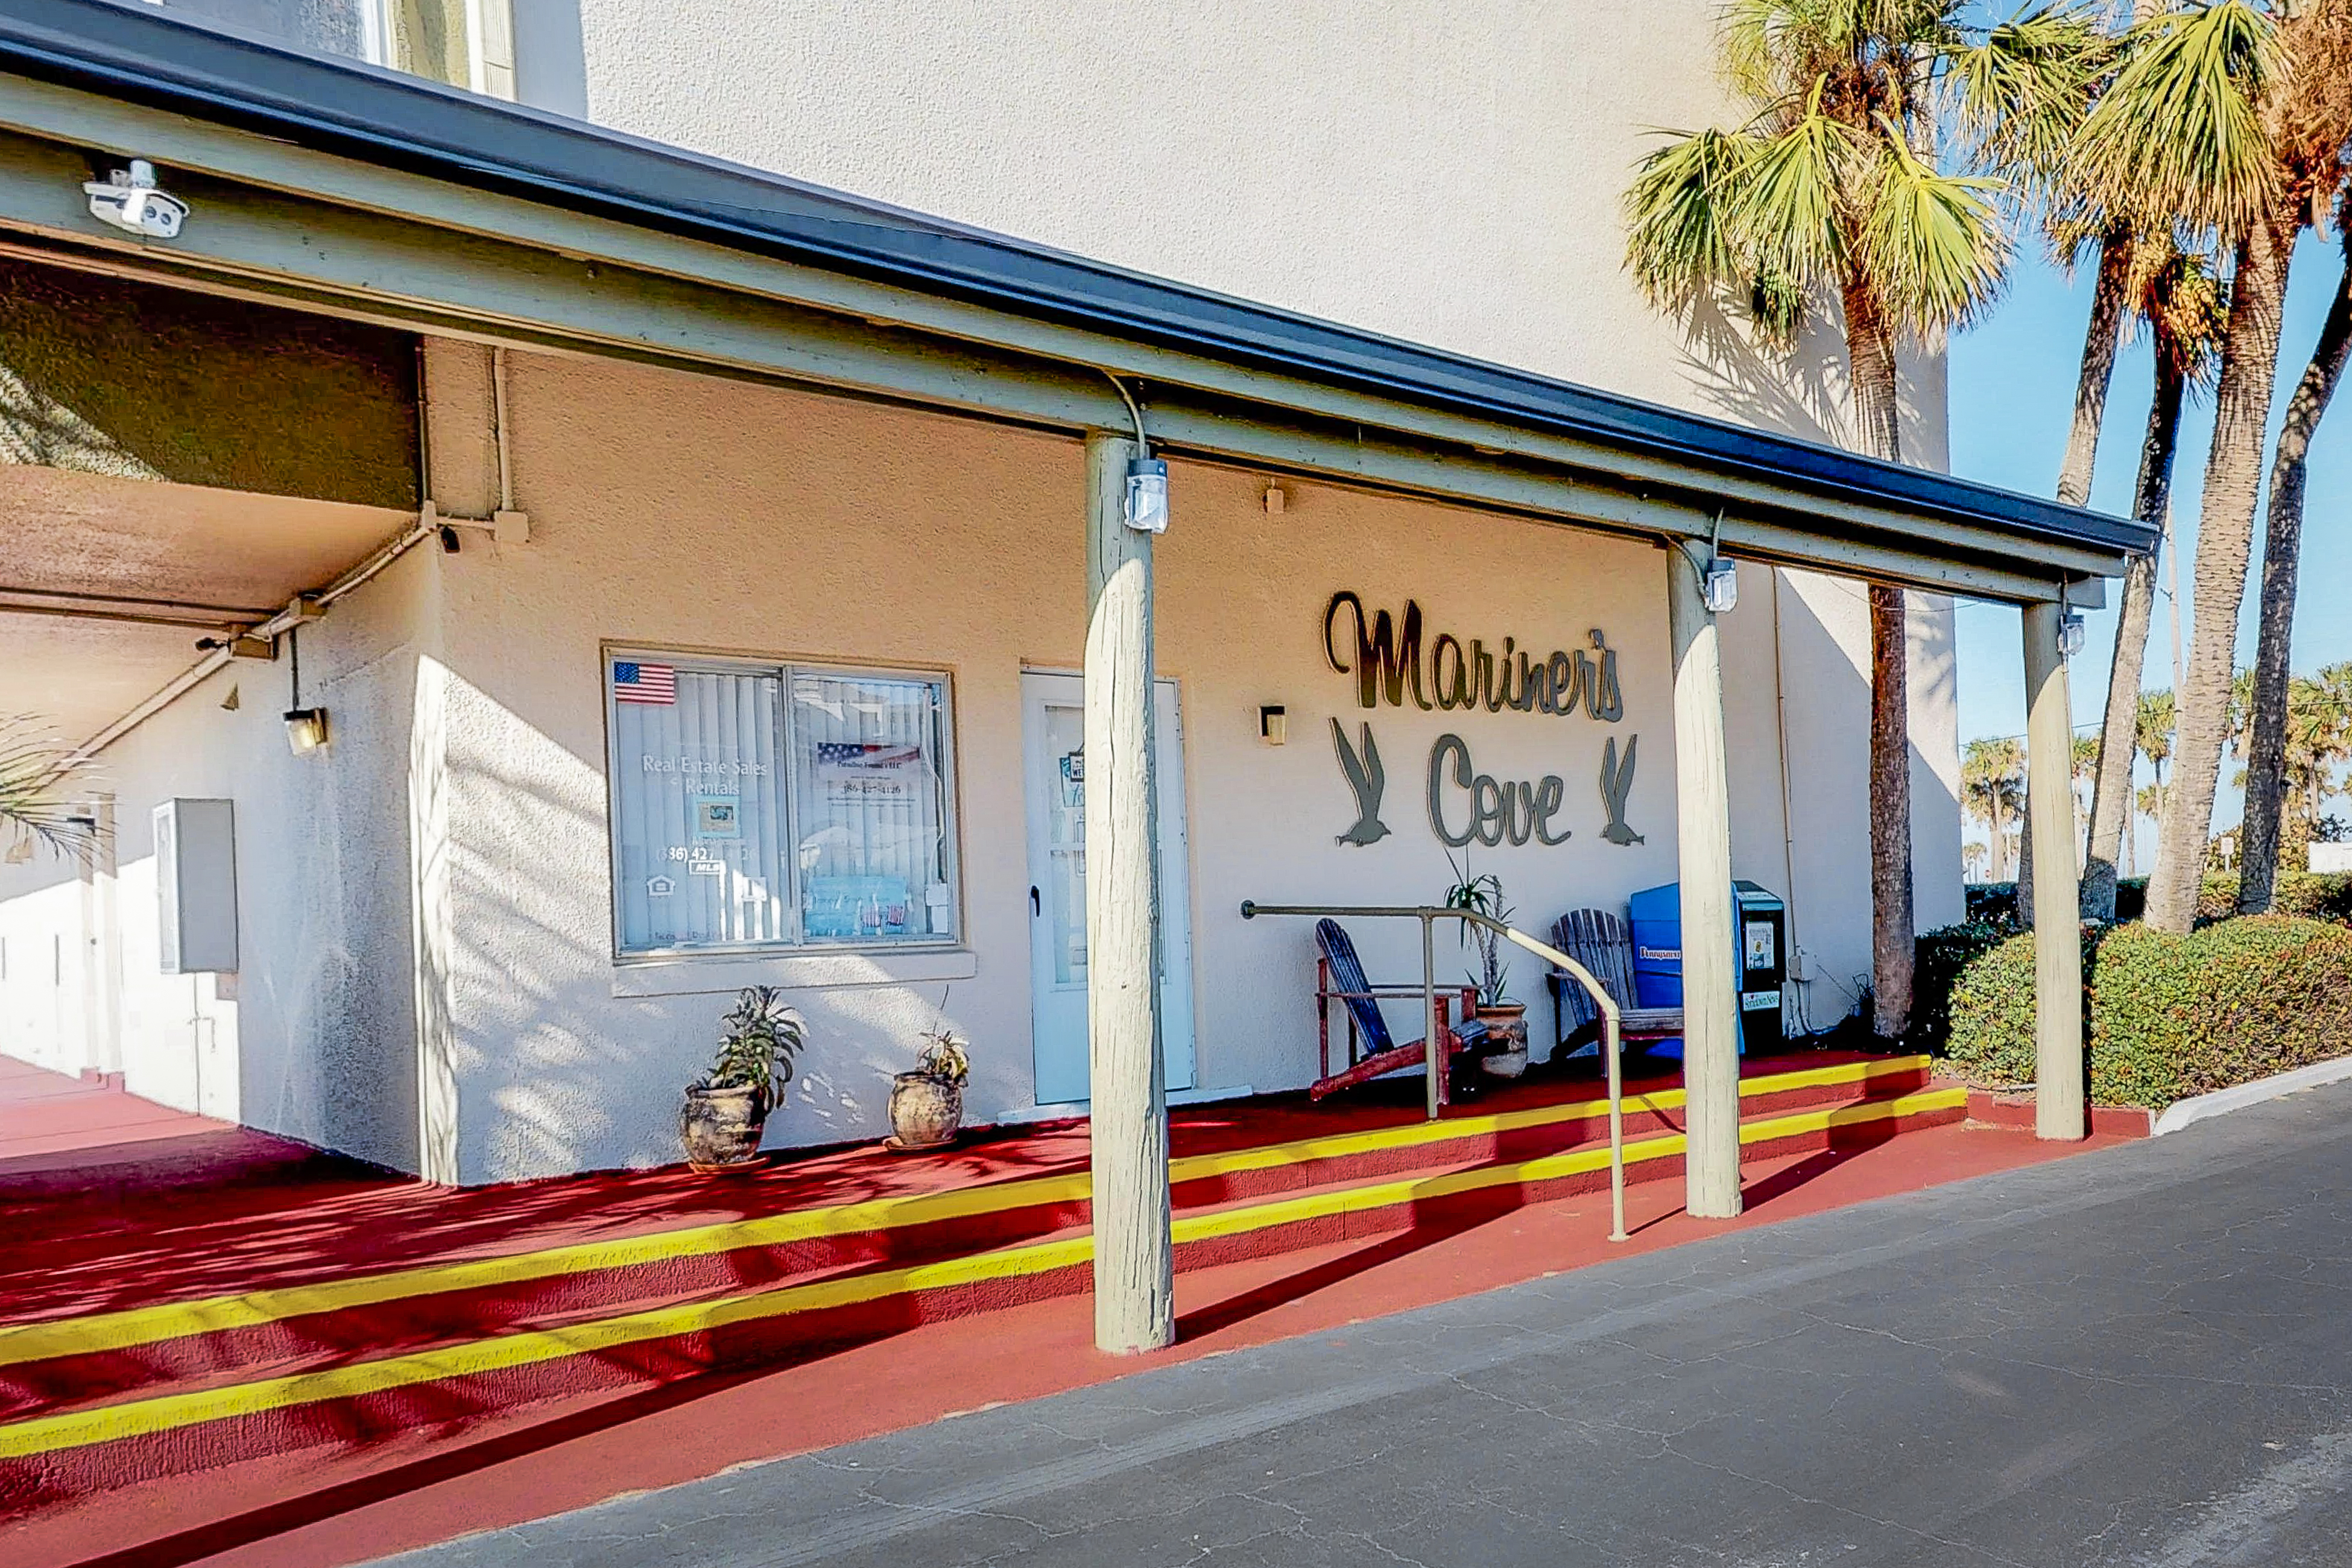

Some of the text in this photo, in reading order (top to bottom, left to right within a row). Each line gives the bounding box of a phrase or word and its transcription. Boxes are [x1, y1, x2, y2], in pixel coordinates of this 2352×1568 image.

[1321, 590, 1623, 722] Mariner's
[642, 754, 768, 776] Real Estate Sales
[686, 777, 741, 795] Rentals
[1426, 733, 1572, 848] Cove
